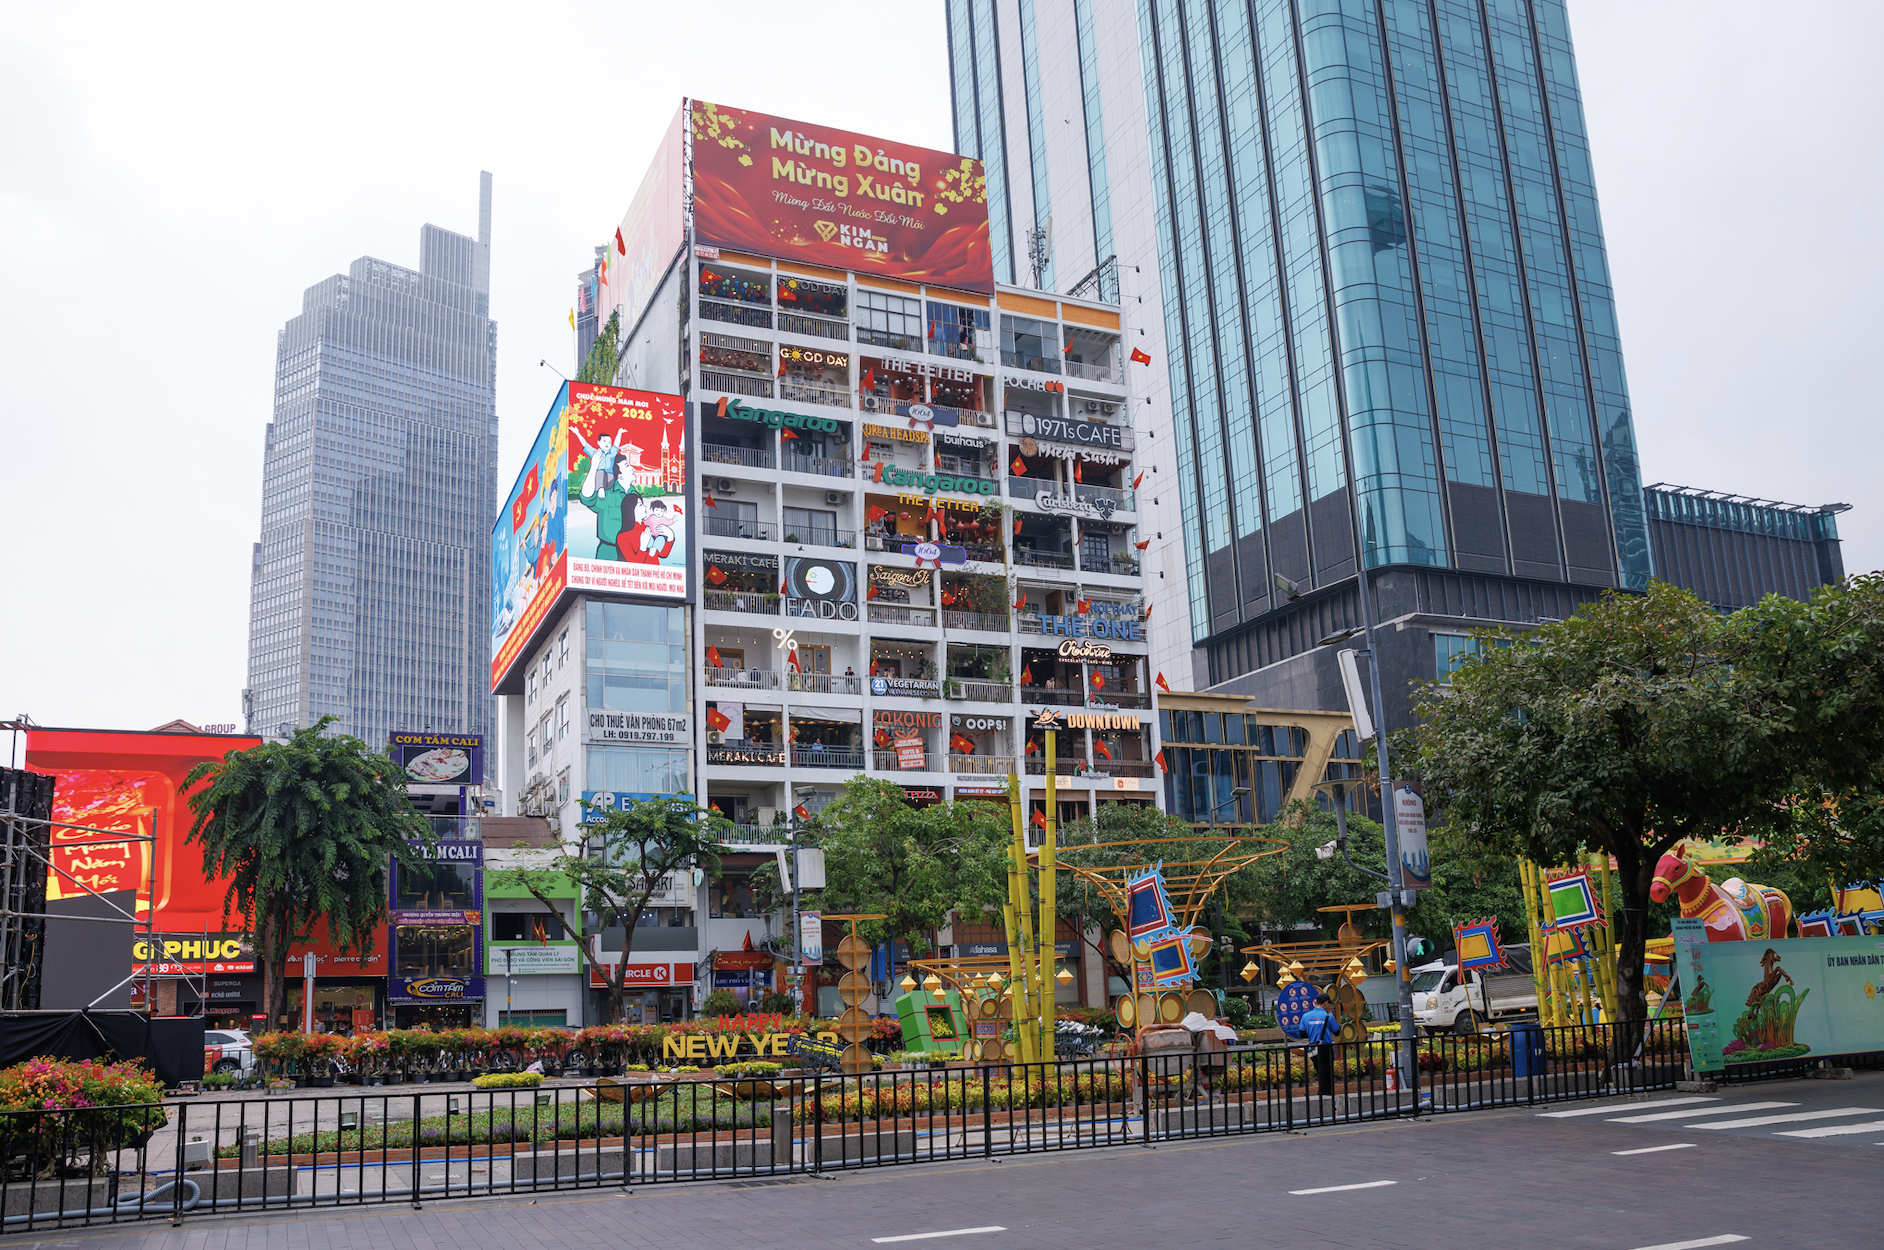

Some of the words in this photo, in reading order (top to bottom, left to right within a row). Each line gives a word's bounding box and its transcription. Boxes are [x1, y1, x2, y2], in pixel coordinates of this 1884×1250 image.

[770, 127, 847, 167] Mừng
[853, 144, 921, 182] Đảng
[772, 157, 849, 197] Mừng
[855, 173, 922, 207] Xuân
[840, 224, 871, 239] KIM
[840, 235, 888, 253] NGAN
[822, 284, 848, 296] DAY
[826, 354, 848, 367] DAY
[882, 355, 912, 373] THE
[917, 361, 974, 383] LETTER
[1003, 376, 1046, 392] POCHA
[622, 407, 653, 421] 2026
[716, 397, 838, 433] Kangaroo
[890, 429, 930, 444] HEADSPA
[1036, 417, 1075, 438] 1971's
[1077, 423, 1121, 445] CAFE
[1079, 448, 1119, 466] Sushi
[872, 462, 994, 495] Kangaroo
[897, 492, 924, 506] THE
[928, 496, 979, 512] LETTER
[1035, 490, 1095, 517] Carlsberg
[703, 553, 747, 566] MERAKI
[870, 565, 913, 587] Saigon
[786, 598, 858, 621] FADO
[1036, 613, 1085, 637] THE
[1092, 618, 1141, 641] ONE
[875, 680, 884, 688] 21
[887, 680, 939, 690] VEGETARIAN
[1089, 702, 1119, 710] Heineken
[204, 724, 236, 734] GROUP
[590, 714, 605, 727] CHO
[606, 713, 624, 729] THUÊ
[625, 714, 640, 730] VĂN
[641, 714, 666, 731] PHÒNG
[667, 718, 687, 731] 67m2
[966, 718, 1007, 730] OOPS!
[395, 735, 422, 744] CƠM
[424, 734, 449, 745] TẤM
[451, 737, 479, 746] CALI
[603, 730, 616, 738] LH:
[618, 731, 674, 741] 0919.797.199
[708, 751, 755, 763] MERAKI
[1081, 770, 1110, 778] Heineken
[448, 845, 477, 859] CALI
[70, 856, 126, 872] Năm
[1827, 954, 1835, 967] ỦY
[1836, 957, 1849, 966] BAN
[1850, 954, 1867, 966] NHÂN
[1867, 954, 1880, 965] DÂN
[625, 969, 651, 978] IRCLE
[718, 1012, 783, 1031] HAPPY
[663, 1035, 740, 1059] NEW
